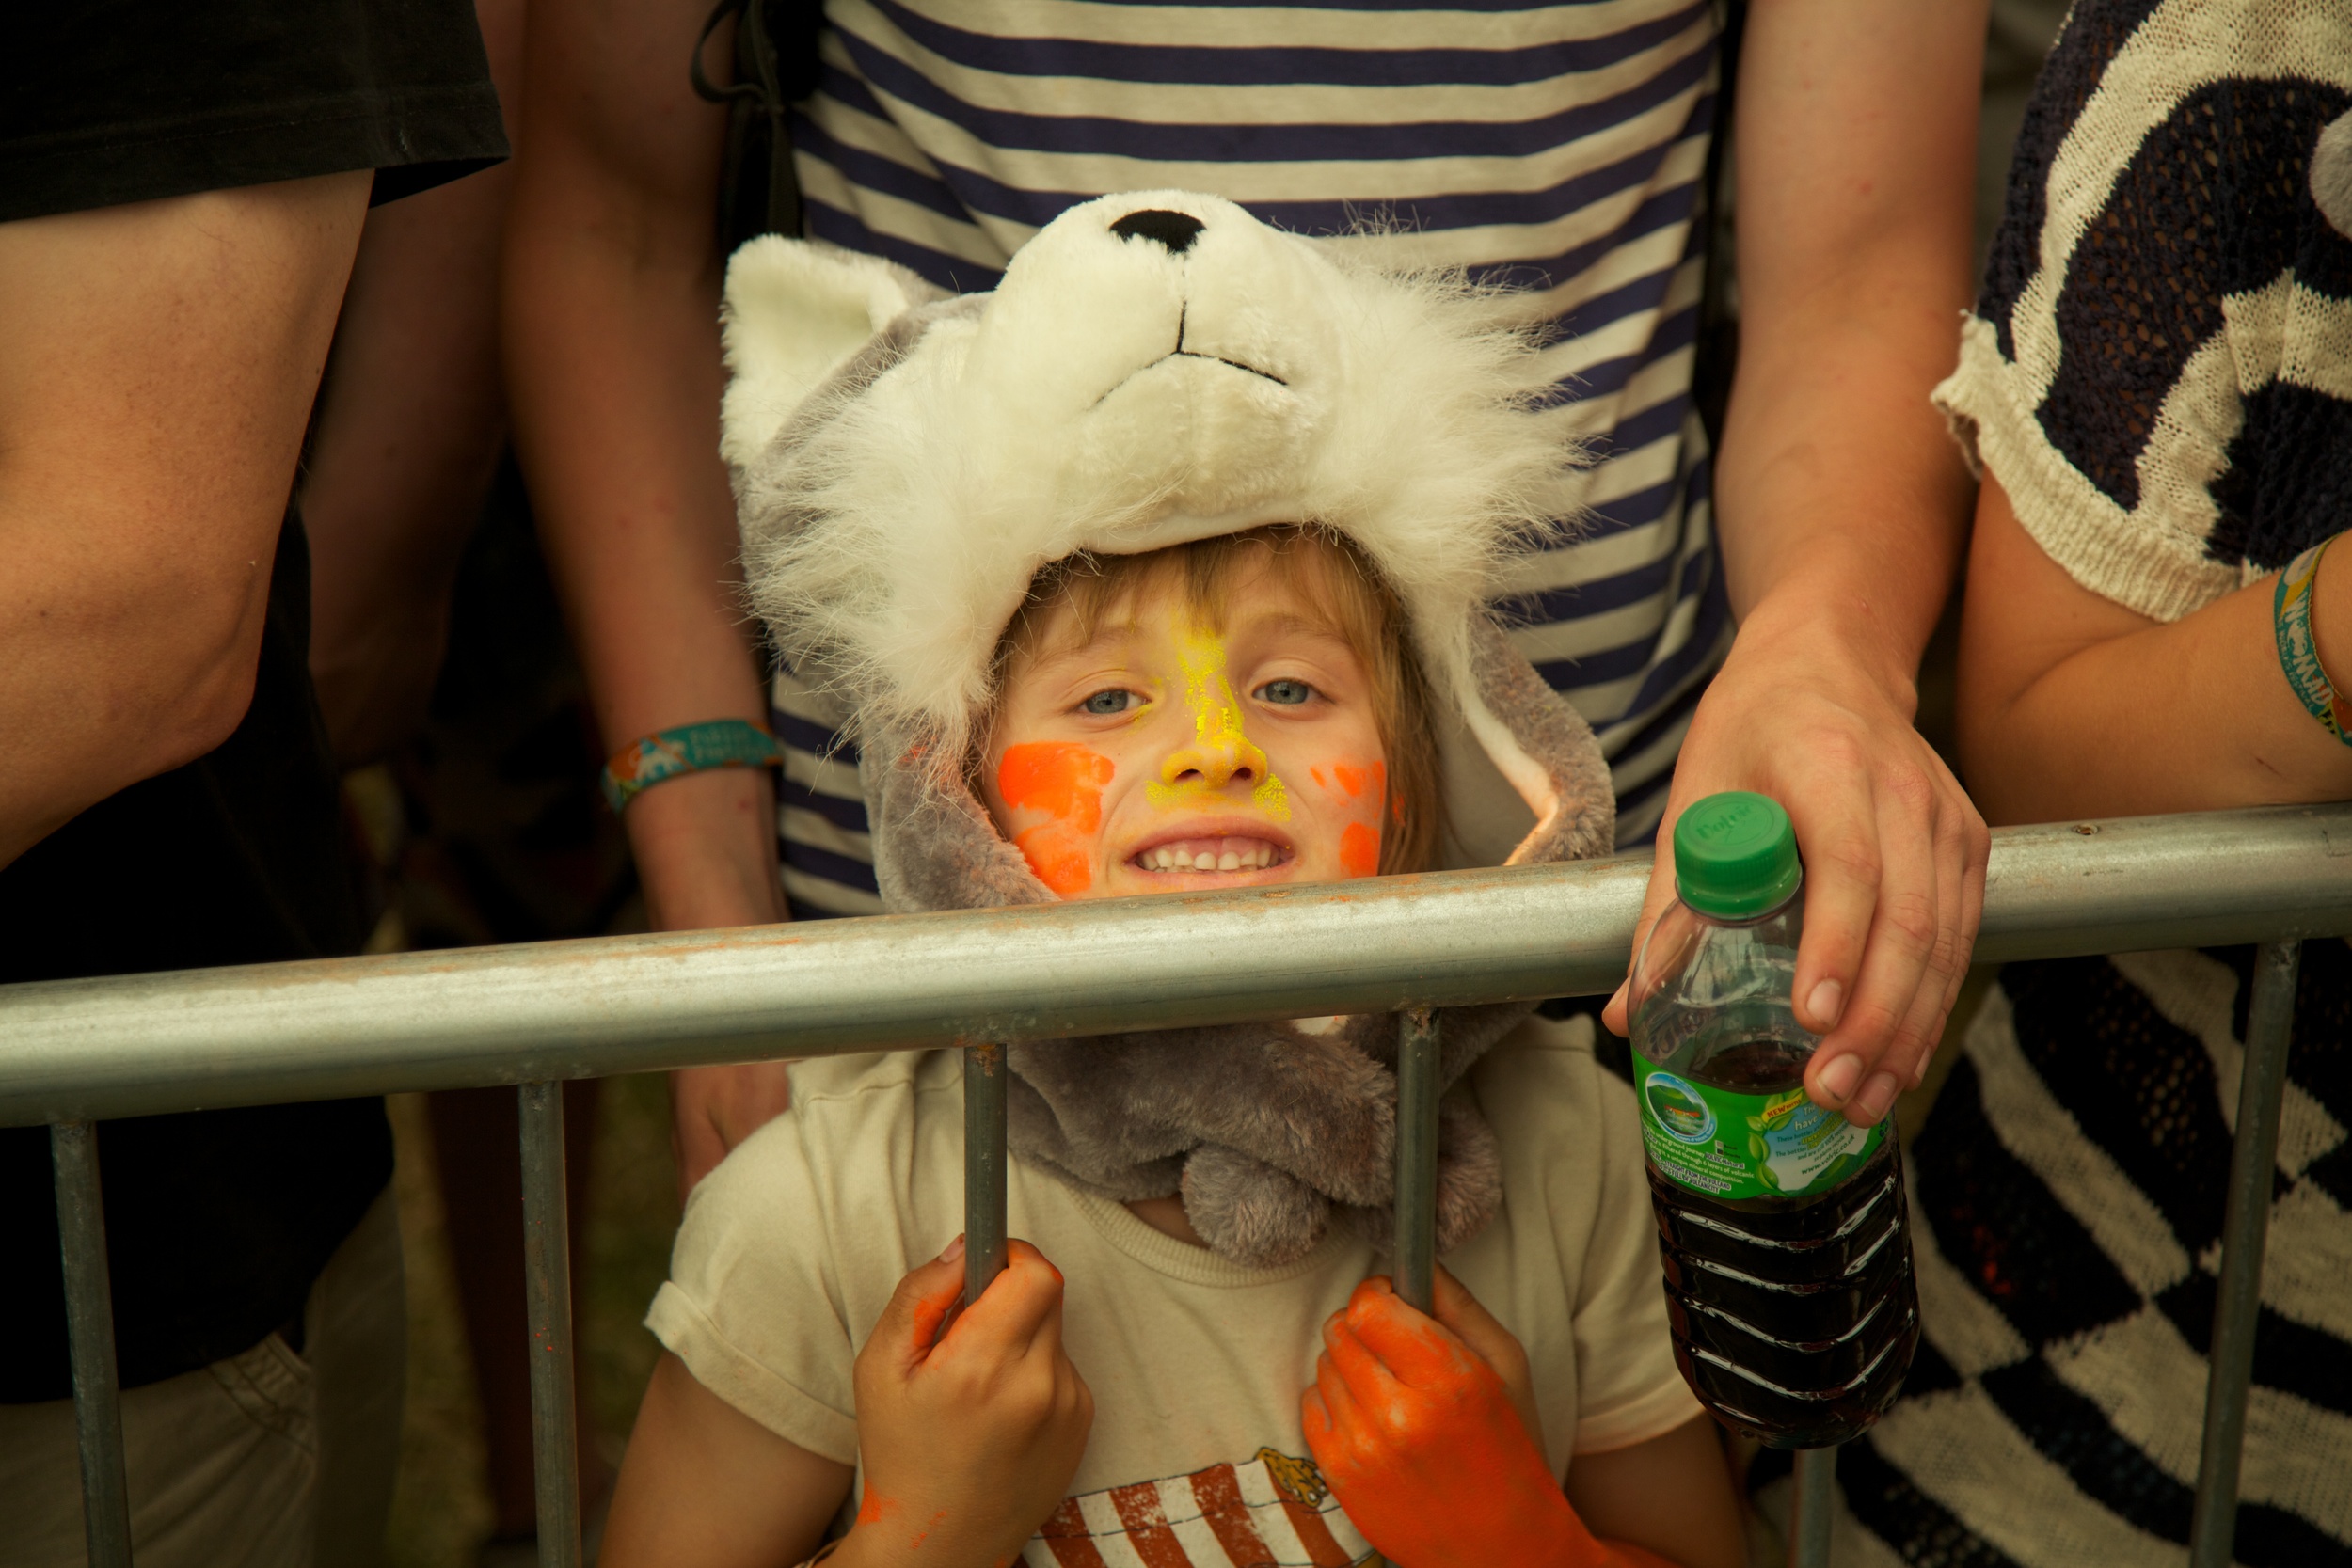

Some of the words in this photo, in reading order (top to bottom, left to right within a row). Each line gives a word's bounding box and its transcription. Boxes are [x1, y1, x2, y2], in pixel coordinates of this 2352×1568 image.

[1767, 1105, 1786, 1118] NEW
[1794, 1115, 1818, 1131] have
[1777, 1134, 1793, 1143] These
[1656, 1131, 1685, 1149] underground
[1685, 1145, 1705, 1158] journey
[1723, 1157, 1745, 1170] Natural
[1661, 1140, 1681, 1156] filtered
[1682, 1150, 1702, 1166] through
[1707, 1160, 1723, 1172] layers
[1730, 1168, 1755, 1179] volcanic
[1787, 1145, 1807, 1156] bottles
[1801, 1134, 1855, 1175] www.volvic.co.uk
[1670, 1154, 1689, 1166] unique
[1688, 1162, 1708, 1174] mineral
[1686, 1167, 1700, 1179] FROM
[1708, 1175, 1731, 1191] VOLCANO
